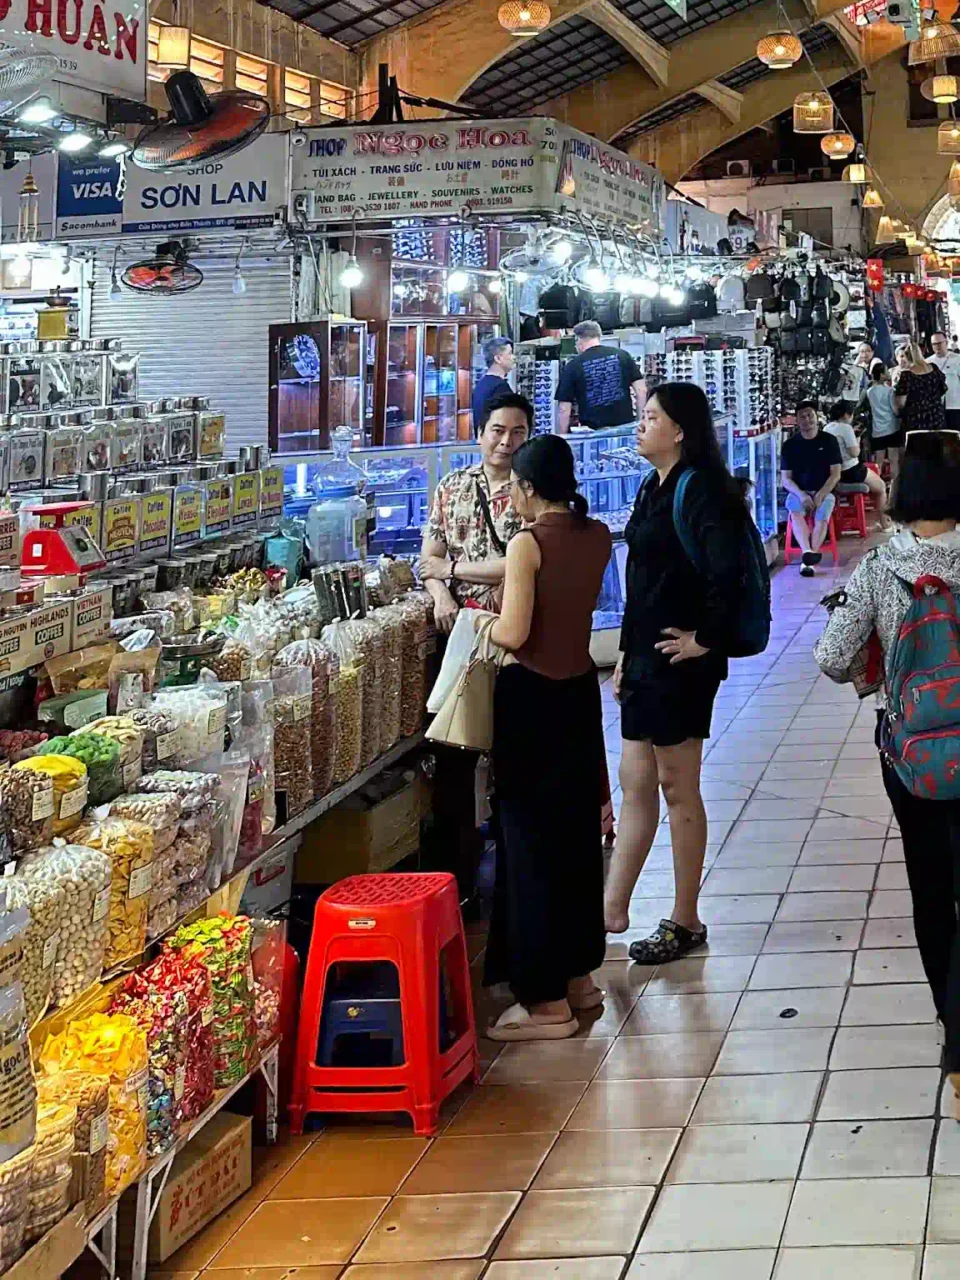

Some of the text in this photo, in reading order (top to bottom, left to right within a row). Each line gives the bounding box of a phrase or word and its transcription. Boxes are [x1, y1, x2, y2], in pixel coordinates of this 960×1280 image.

[309, 139, 348, 157] SHOP
[456, 126, 532, 150] Hoa
[187, 163, 223, 176] SHOP
[370, 165, 400, 174] TRANG
[71, 181, 112, 199] VISA
[141, 180, 267, 209] SƠN LAN
[338, 193, 356, 202] BAG
[368, 190, 419, 200] JEWELLERY
[432, 187, 480, 198] SOUVENIRS
[491, 185, 533, 195] WATCHES
[410, 200, 428, 209] HAND
[430, 199, 453, 208] PHONE
[61, 219, 117, 232] Sacombank
[31, 607, 69, 628] HIGHLANDS
[79, 608, 101, 624] COFFEE
[37, 625, 63, 642] COFFEE
